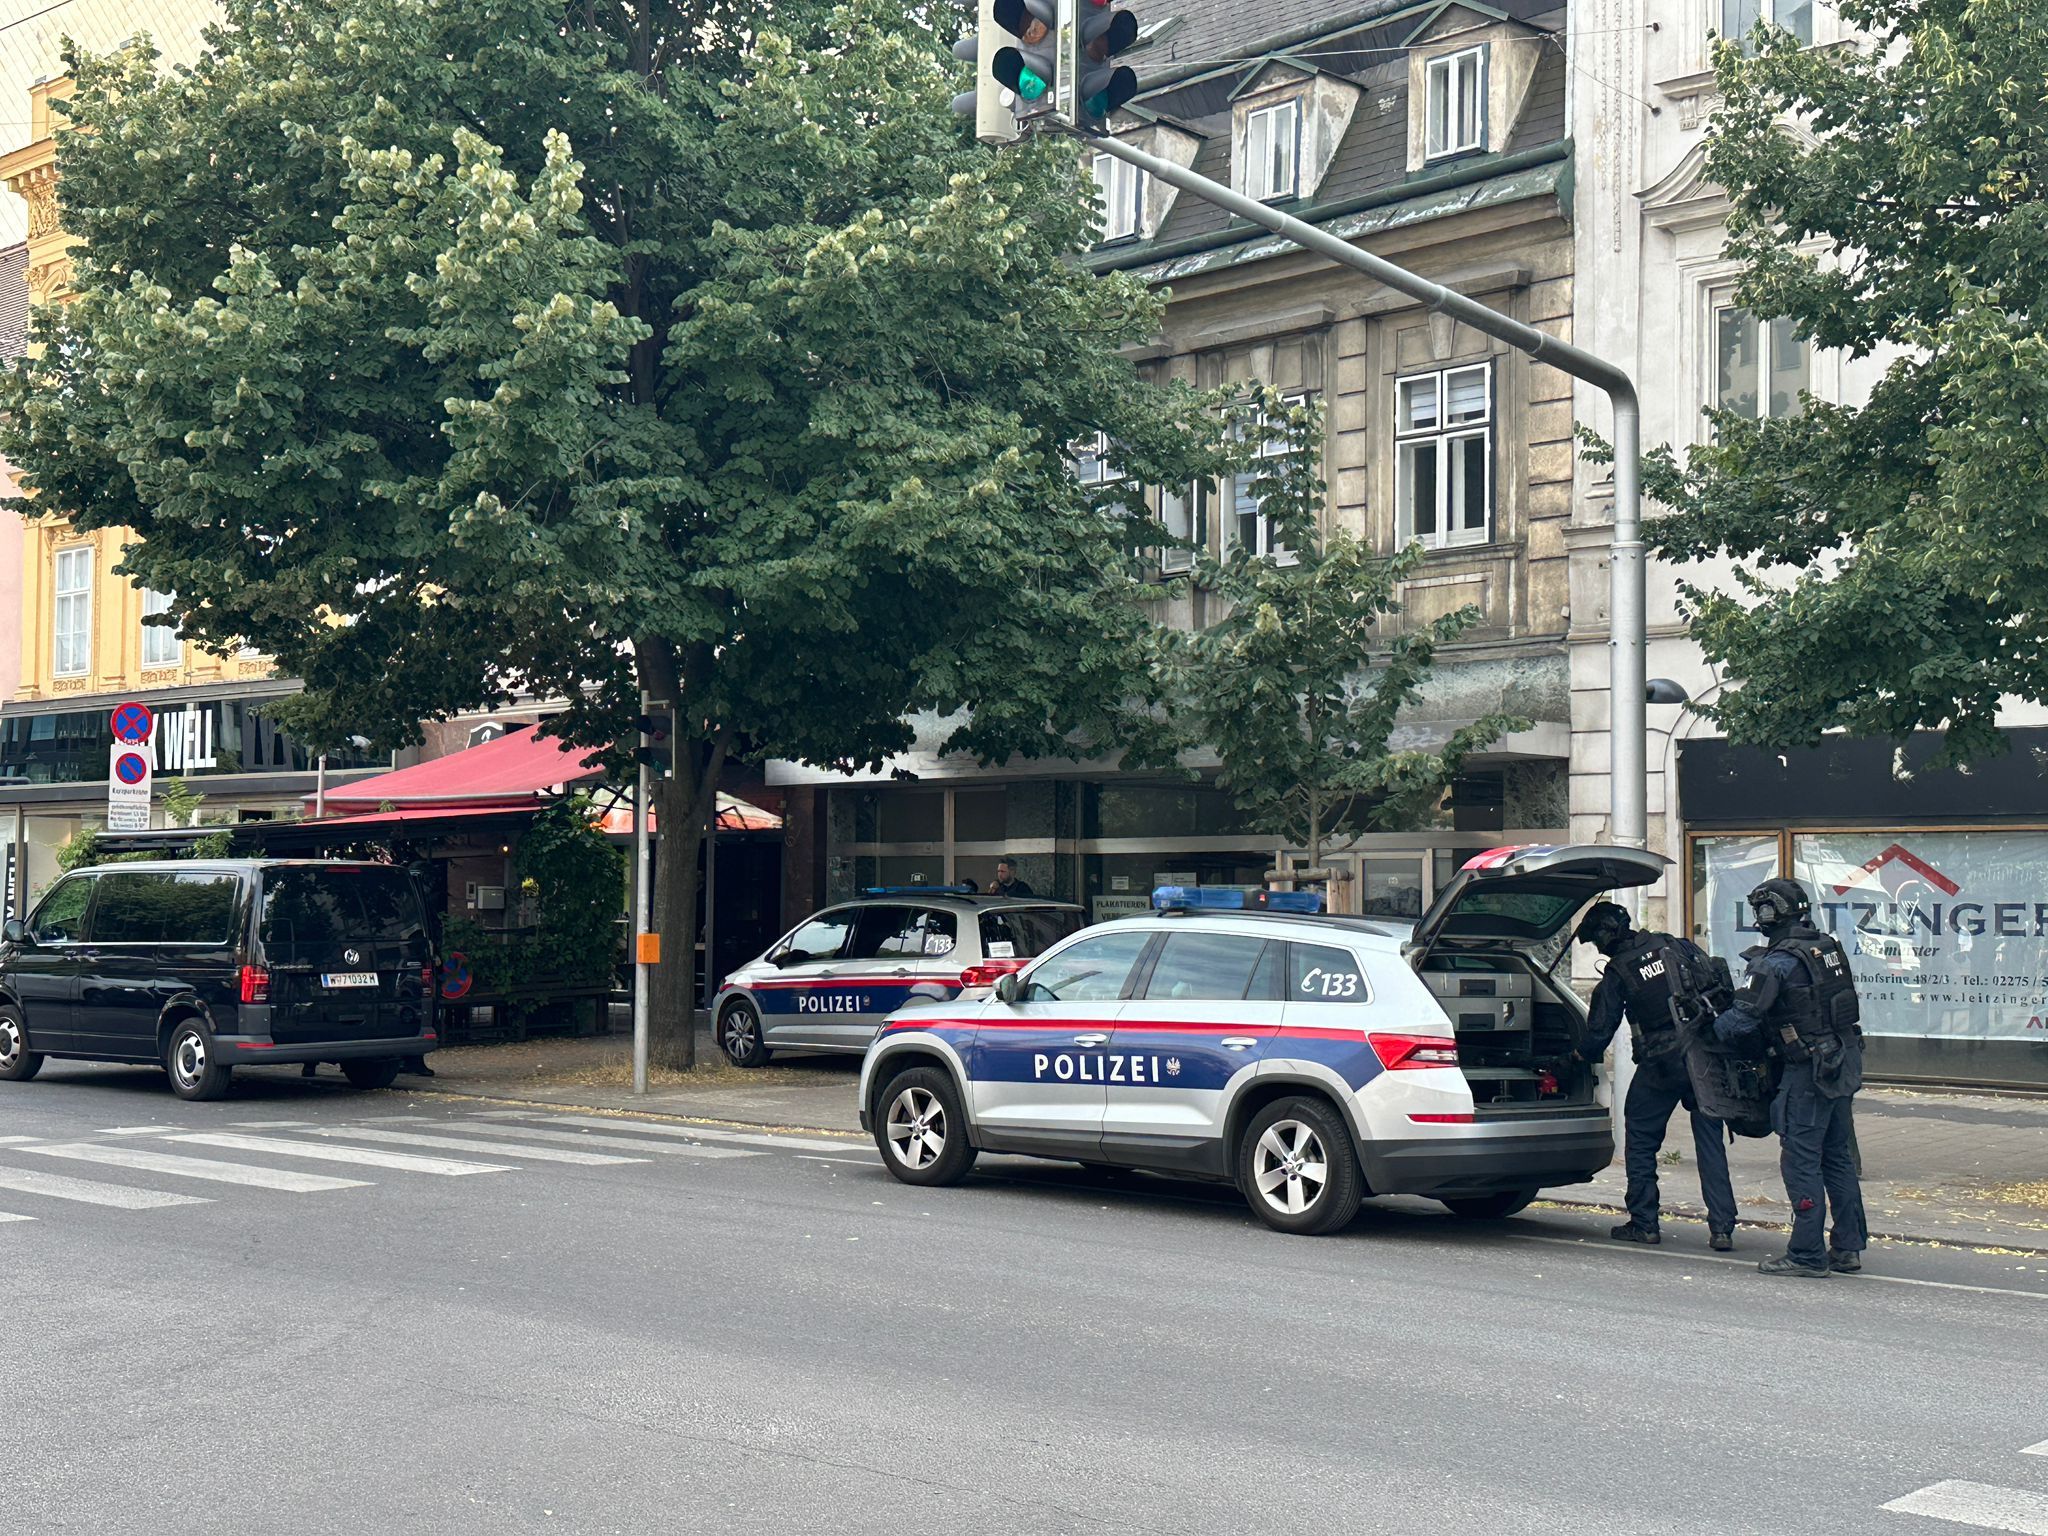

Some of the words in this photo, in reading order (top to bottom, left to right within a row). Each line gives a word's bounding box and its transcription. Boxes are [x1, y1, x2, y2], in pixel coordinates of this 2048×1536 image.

[163, 709, 217, 770] WELL
[1096, 900, 1146, 909] PLAKATIEREN
[1736, 901, 2048, 936] LTZINGE
[933, 938, 951, 953] 133
[1639, 960, 1665, 981] POLIZE
[1853, 973, 1909, 985] nhofsring
[1912, 974, 1949, 985] 48/2/3
[1992, 976, 2029, 987] 02275
[1320, 973, 1358, 996] 133
[799, 995, 860, 1013] POLIZEI
[1034, 1054, 1159, 1082] POLIZEI
